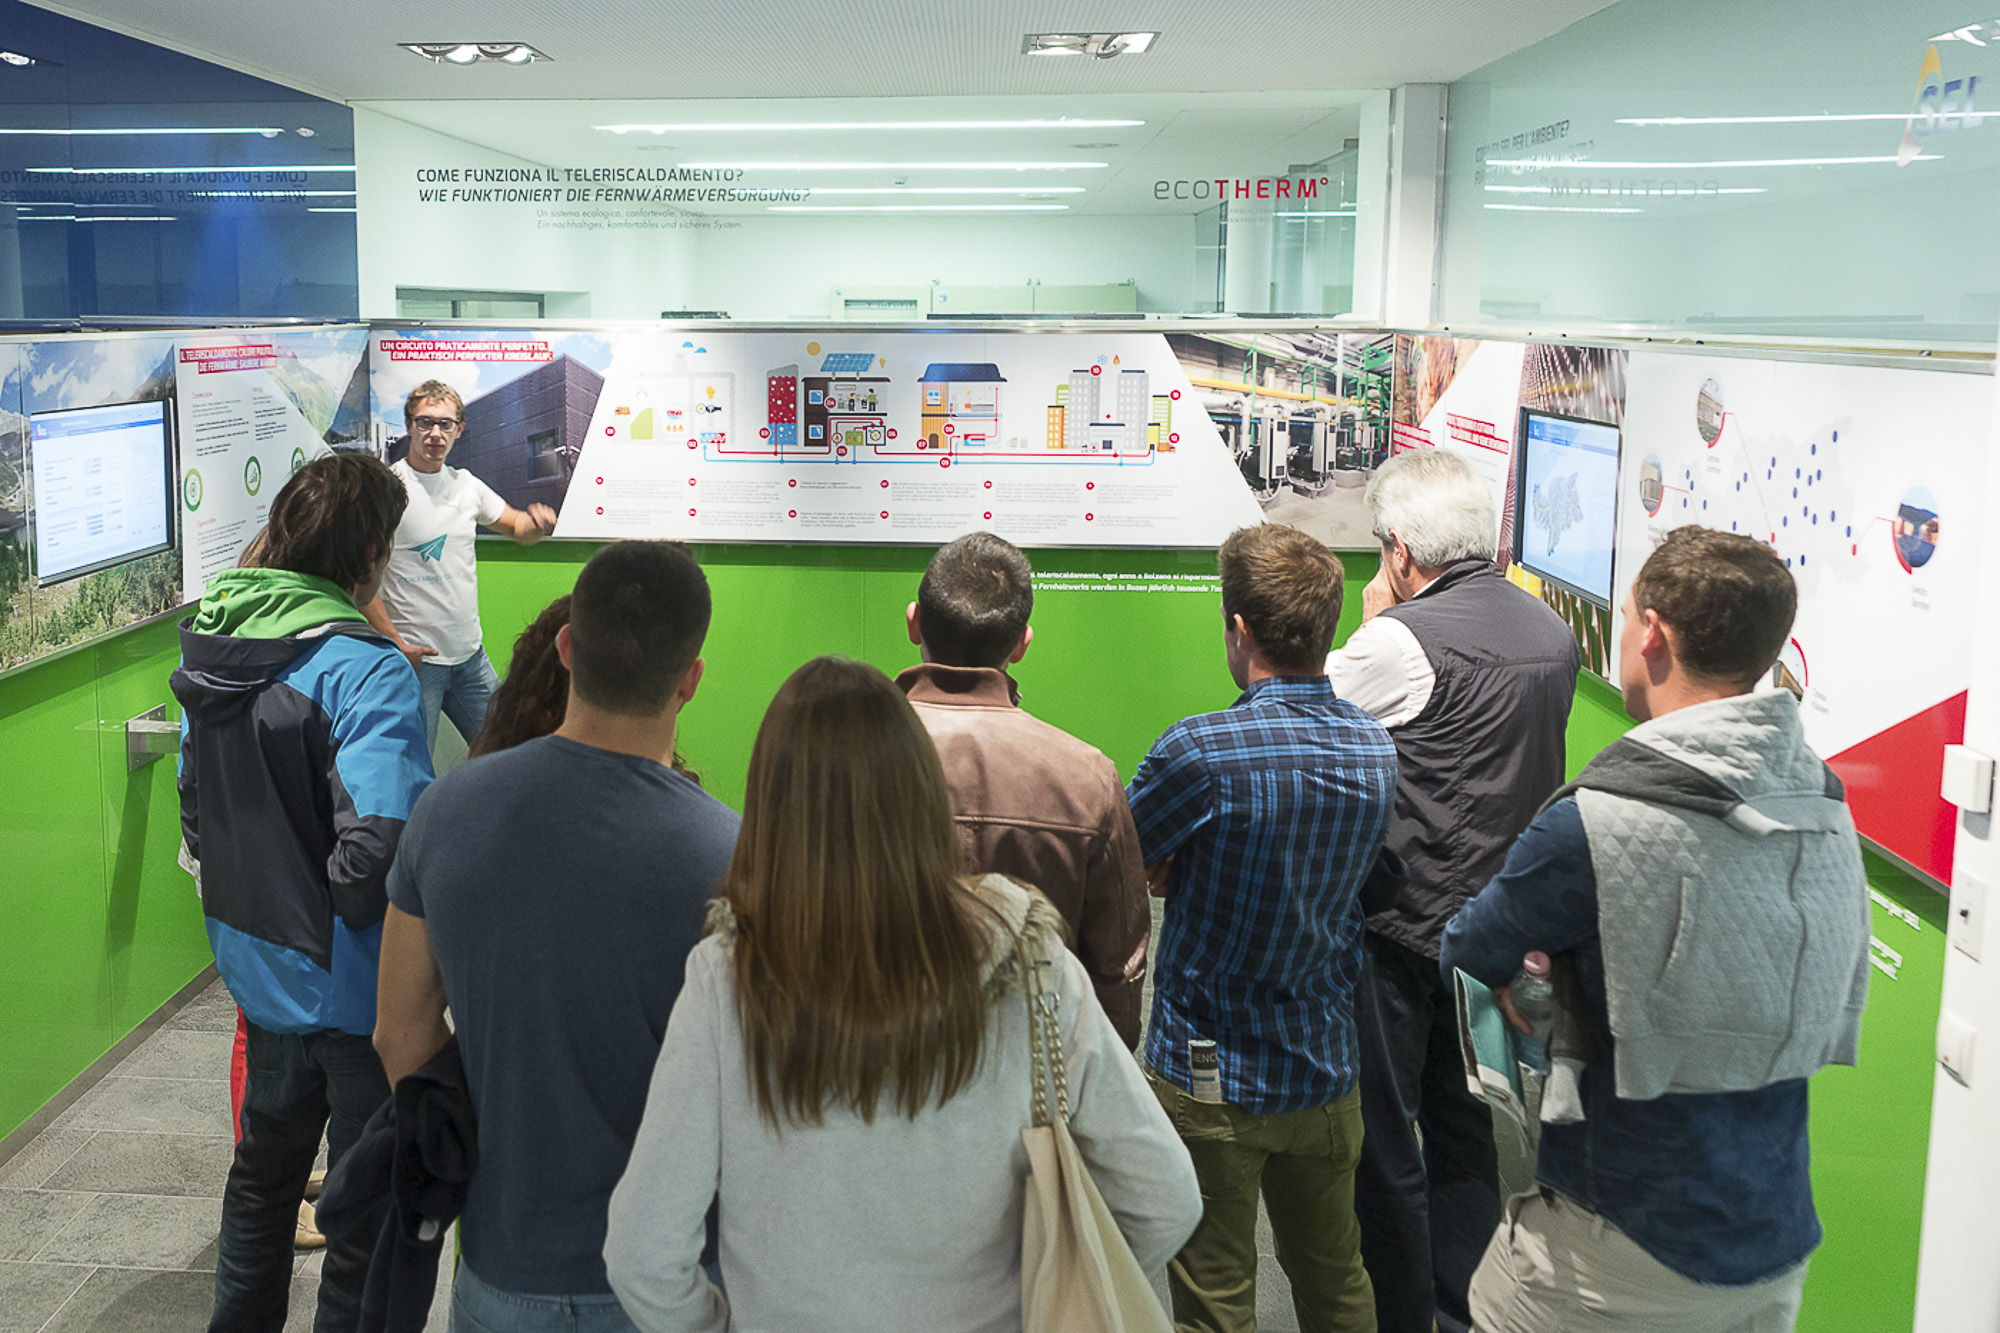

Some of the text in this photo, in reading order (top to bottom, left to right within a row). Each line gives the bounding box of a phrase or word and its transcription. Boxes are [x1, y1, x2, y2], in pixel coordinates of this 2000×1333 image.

[1915, 75, 1984, 137] SEL
[416, 168, 744, 182] COME FUNZIONA IL TELERISCALDAMENTO?
[419, 185, 811, 202] WIE FUNKTIONIERT DIE FERNWÄRMEVERSORGUNG?
[551, 209, 580, 218] sistema
[661, 220, 678, 229] und
[679, 219, 711, 229] sicheres
[382, 342, 394, 350] UN
[396, 342, 434, 350] CIRCUITO
[435, 342, 500, 351] PRATICAMENTE
[393, 351, 406, 360] EIN
[408, 351, 454, 360] PRAKTISCH
[456, 352, 503, 360] PERFEKTER
[1103, 573, 1118, 581] ogni
[1091, 583, 1117, 591] werden
[1148, 584, 1175, 593] jährlich
